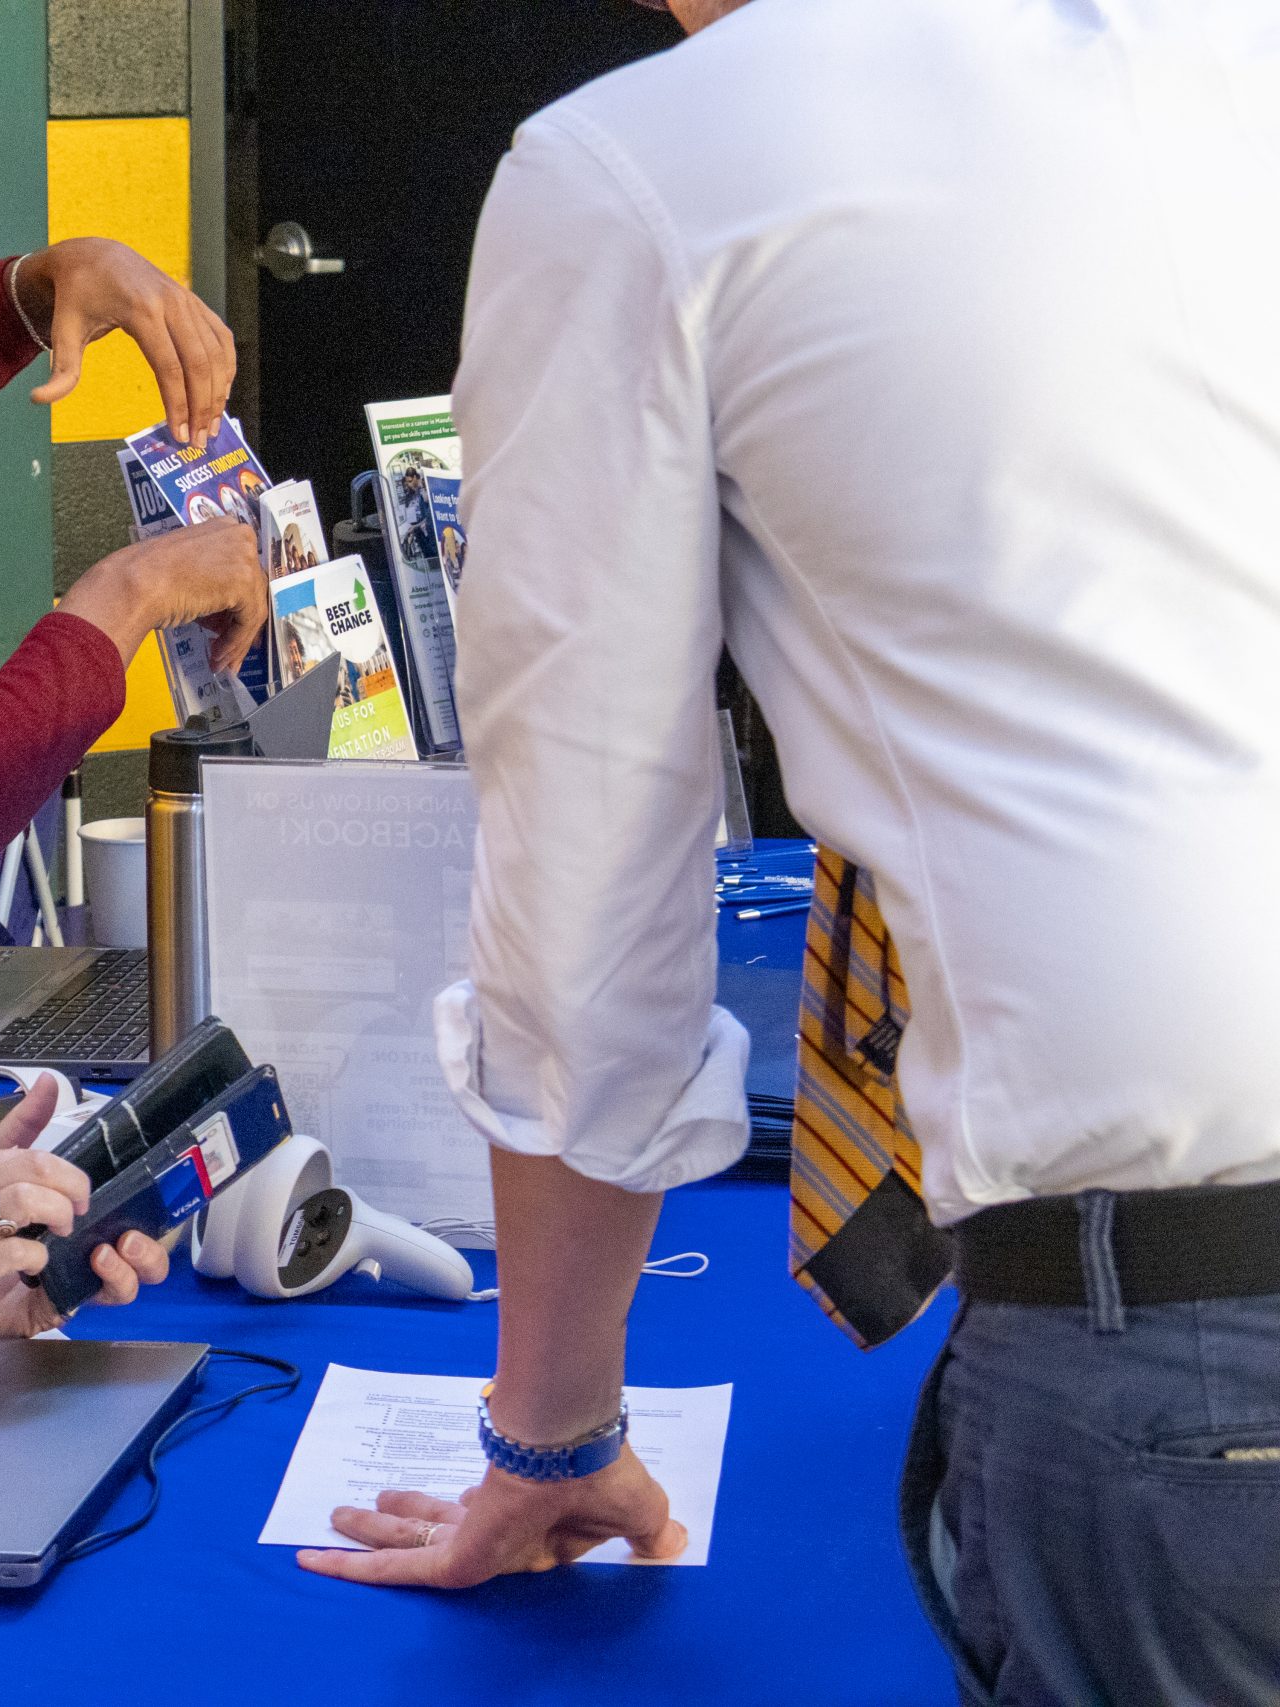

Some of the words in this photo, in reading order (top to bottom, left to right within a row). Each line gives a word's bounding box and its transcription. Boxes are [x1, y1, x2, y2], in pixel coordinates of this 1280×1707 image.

[382, 421, 405, 430] Interested
[150, 453, 182, 478] SKILLS
[178, 446, 207, 464] TODAY
[175, 464, 214, 493] SUCCESS
[208, 447, 250, 476] TOMORROW
[433, 492, 451, 508] Looking
[436, 510, 448, 522] Want
[325, 601, 352, 622] BEST
[330, 610, 373, 636] CHANCE
[336, 712, 352, 729] US
[353, 702, 376, 721] FOR
[172, 1197, 201, 1218] VISA
